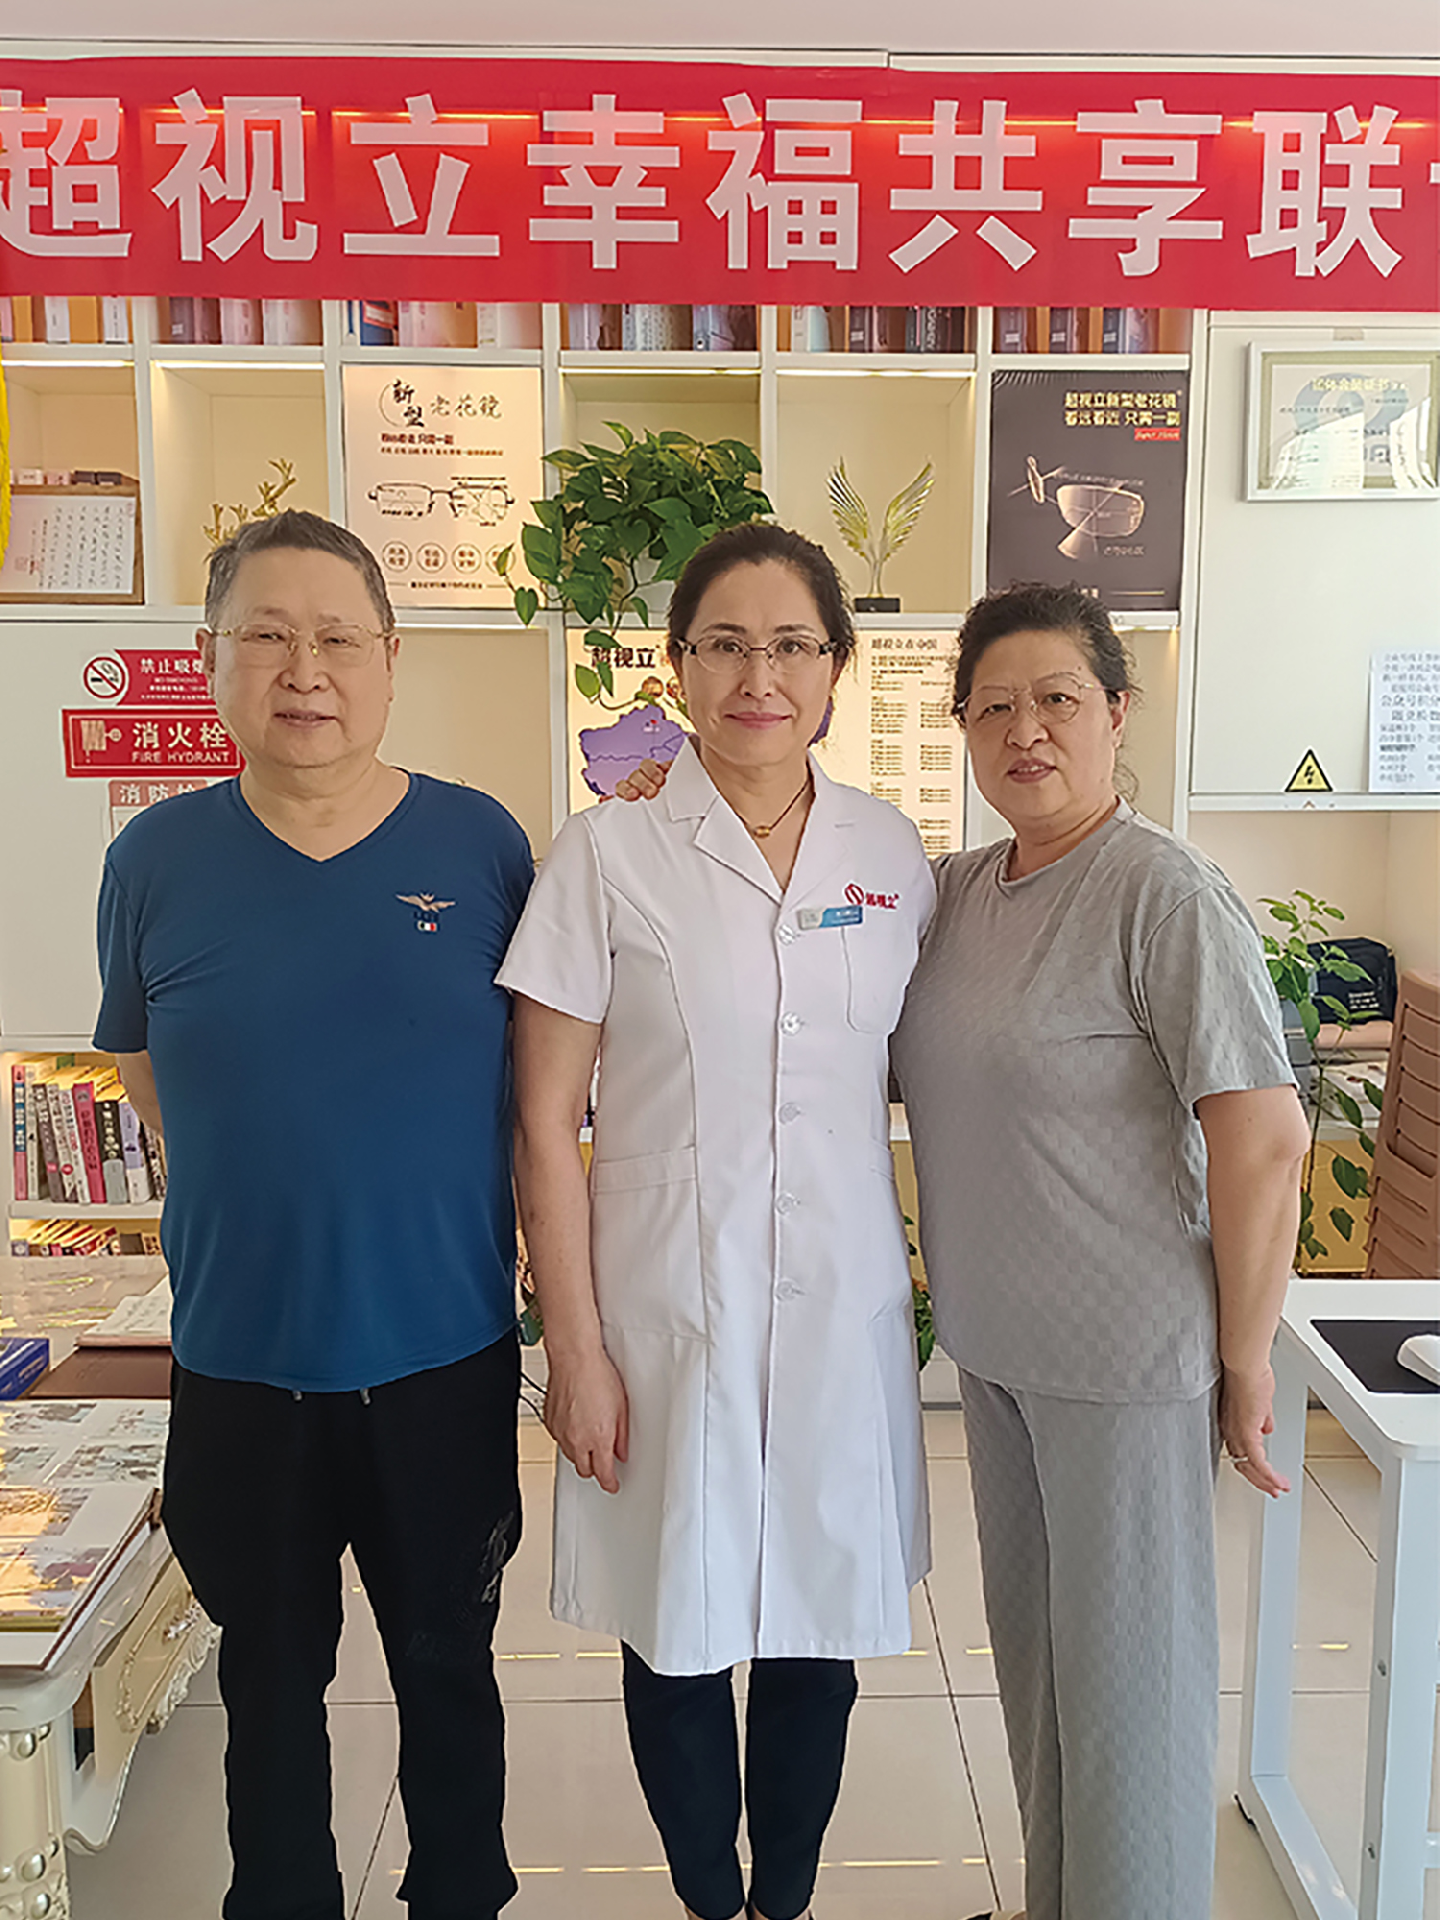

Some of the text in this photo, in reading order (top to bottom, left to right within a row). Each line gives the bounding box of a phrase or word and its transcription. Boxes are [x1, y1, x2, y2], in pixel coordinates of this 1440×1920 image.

[0, 88, 1440, 276] 超视立幸福共享联
[132, 721, 228, 749] 消火栓
[131, 751, 230, 764] FIRE HYDRANT
